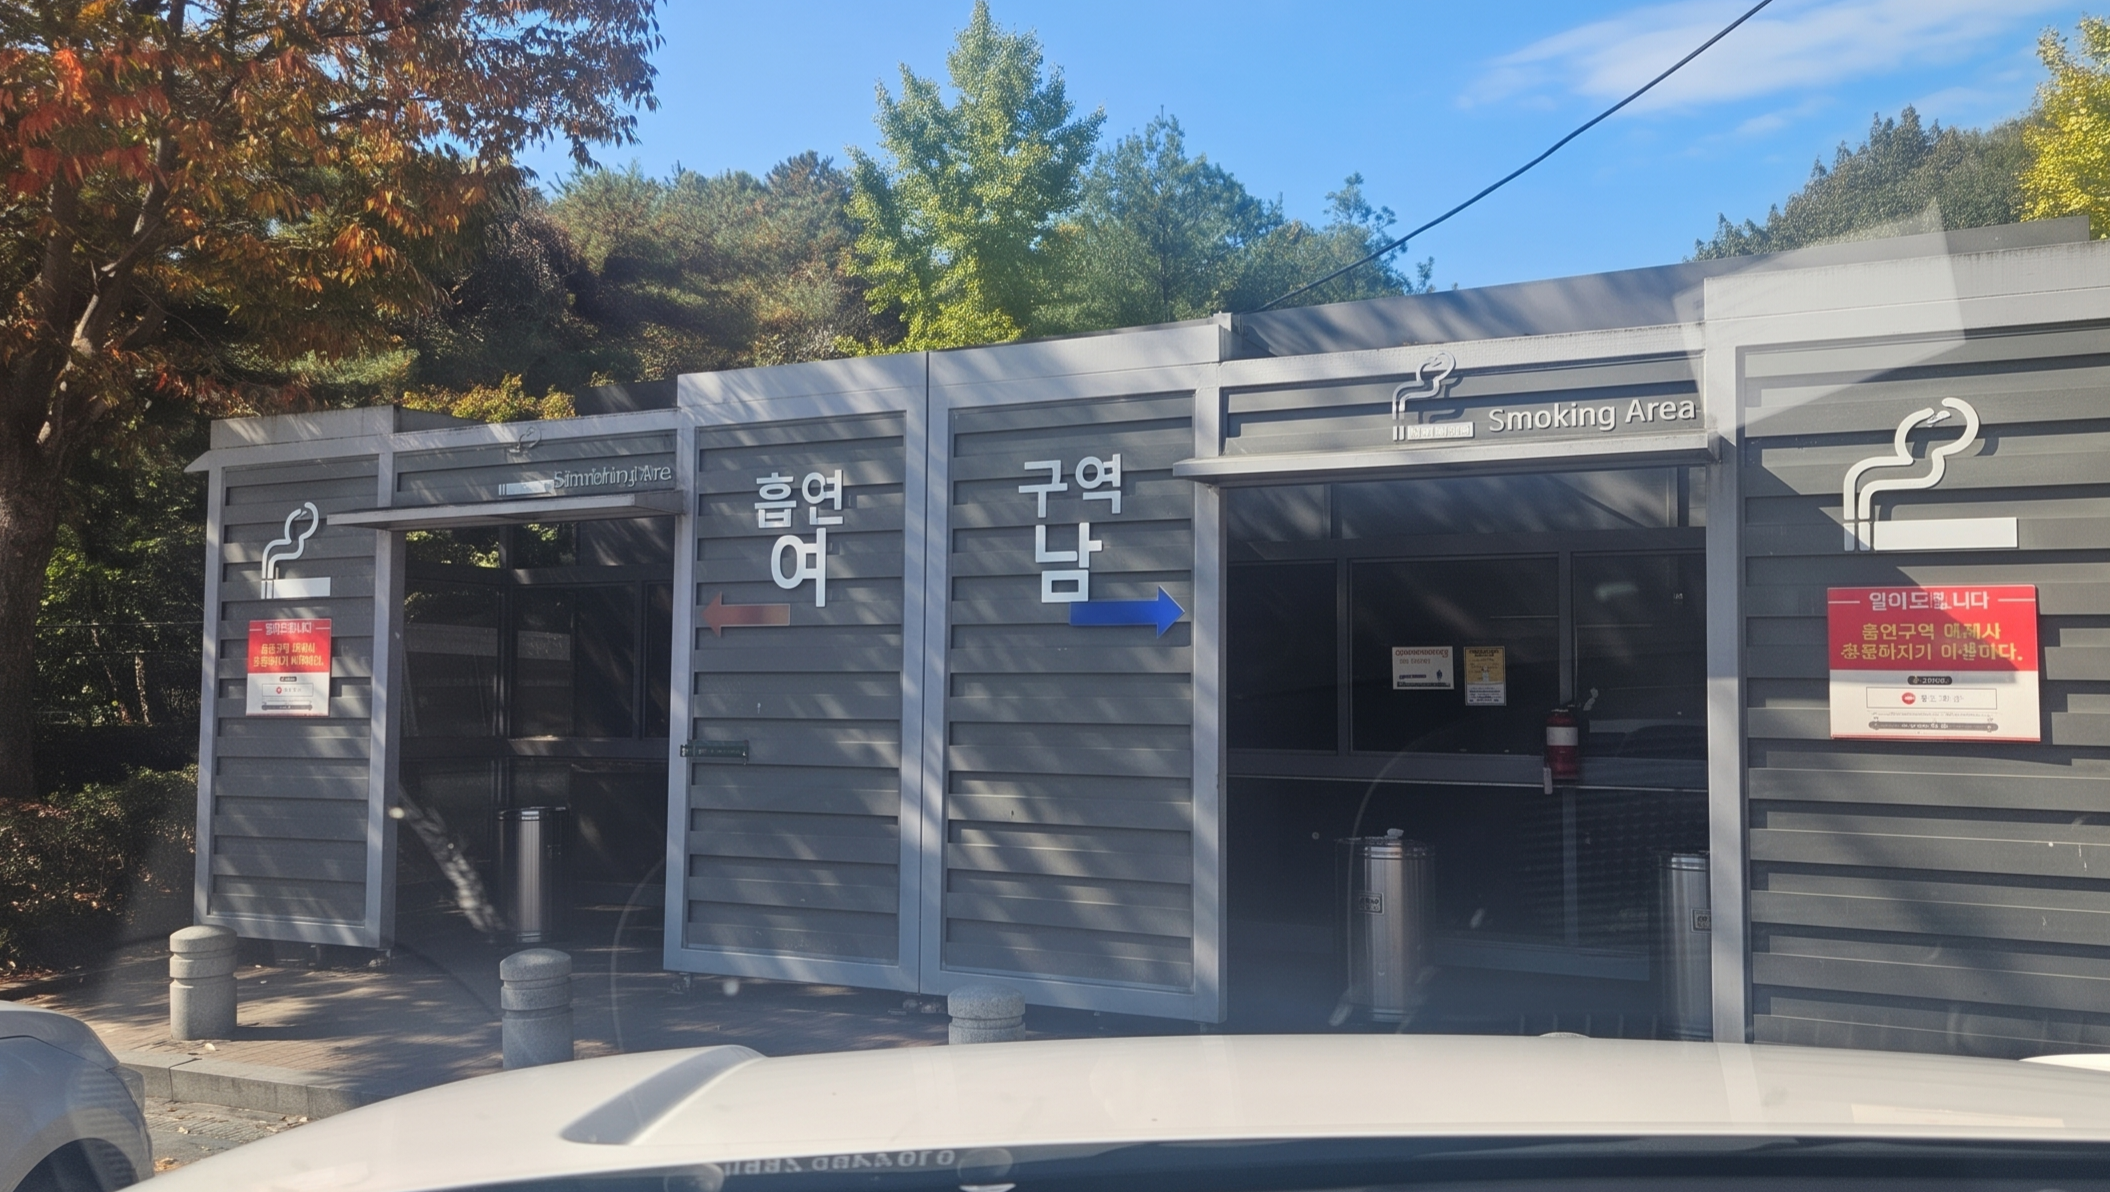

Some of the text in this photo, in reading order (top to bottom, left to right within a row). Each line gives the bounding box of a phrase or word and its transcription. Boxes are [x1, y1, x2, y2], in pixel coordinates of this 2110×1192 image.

[1488, 399, 1697, 432] Smoking Area
[754, 453, 1122, 529] 흡연 구역
[770, 527, 827, 608] 여
[1035, 522, 1102, 604] 남
